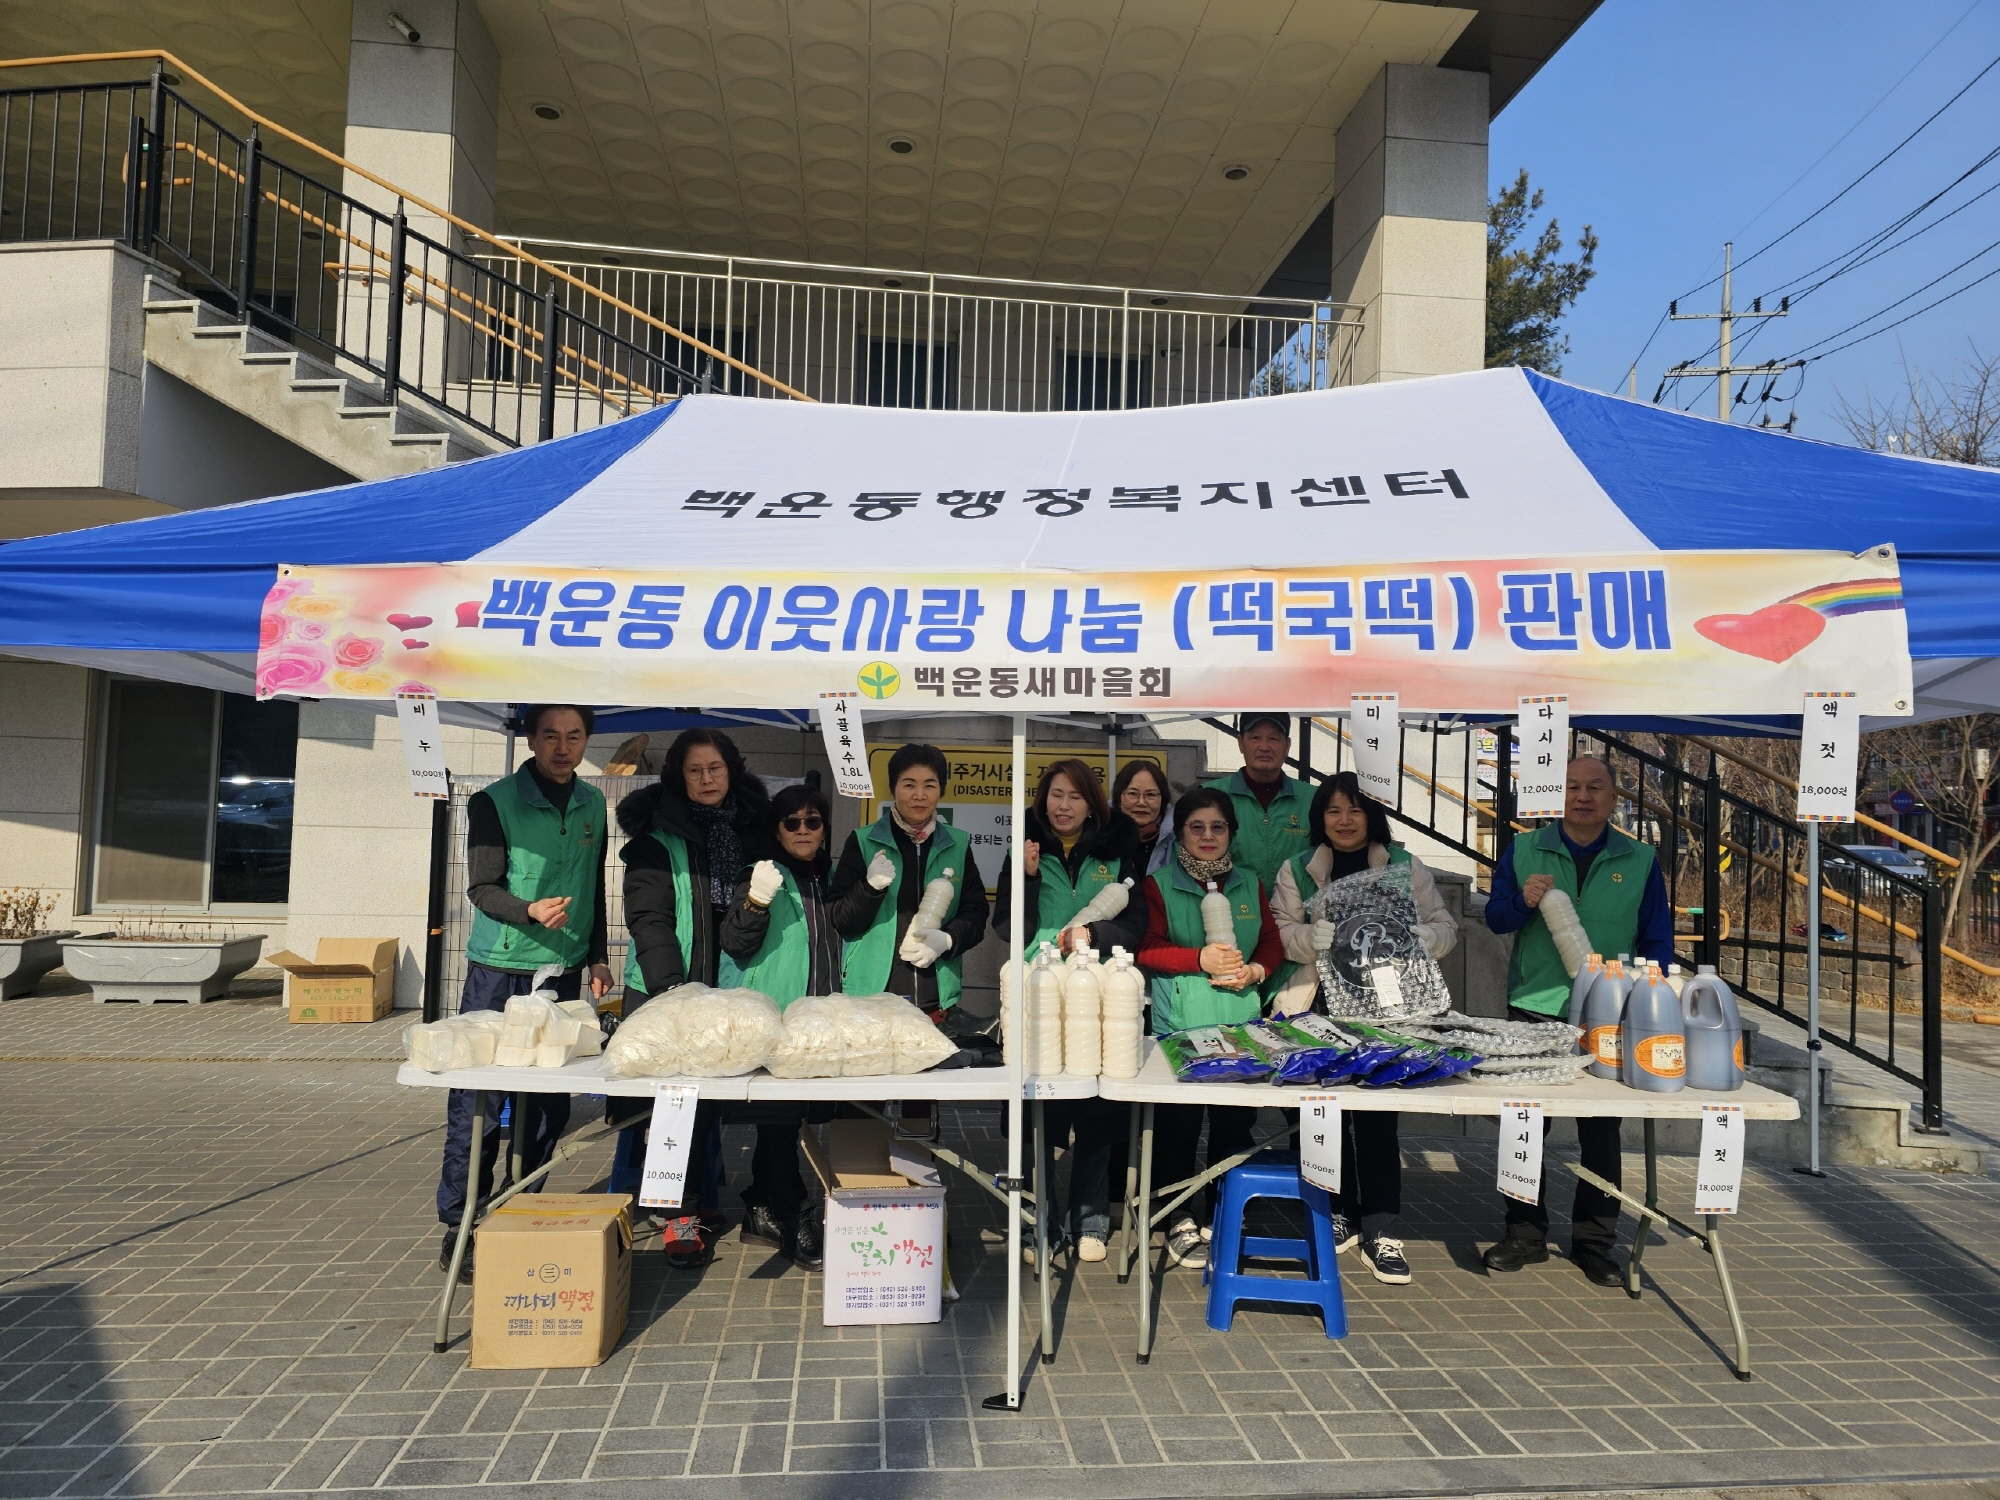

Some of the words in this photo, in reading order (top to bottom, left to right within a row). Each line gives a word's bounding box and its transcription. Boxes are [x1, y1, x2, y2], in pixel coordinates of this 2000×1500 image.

[682, 467, 1470, 521] 백운동행정복지센터
[482, 578, 685, 650] 백운동
[703, 584, 985, 653] 이웃사랑
[1007, 587, 1143, 653] 나눔
[1173, 573, 1475, 653] (떡국떡)
[1502, 568, 1671, 652] 판매
[912, 665, 1172, 700] 백운동새마을회
[1366, 705, 1380, 751] 미역
[1537, 704, 1554, 767] 다시마
[1820, 700, 1838, 759] 액젓
[411, 769, 444, 780] 10,000원
[840, 767, 863, 777] 1.8L
[1522, 784, 1563, 794] 12,000원
[1801, 785, 1848, 796] 18,000원
[1313, 1105, 1326, 1146] 미역
[1514, 1109, 1530, 1163] 다시마
[1714, 1114, 1728, 1162] 액젓
[646, 1170, 683, 1182] 10,000원
[1699, 1184, 1733, 1193] 18,000원
